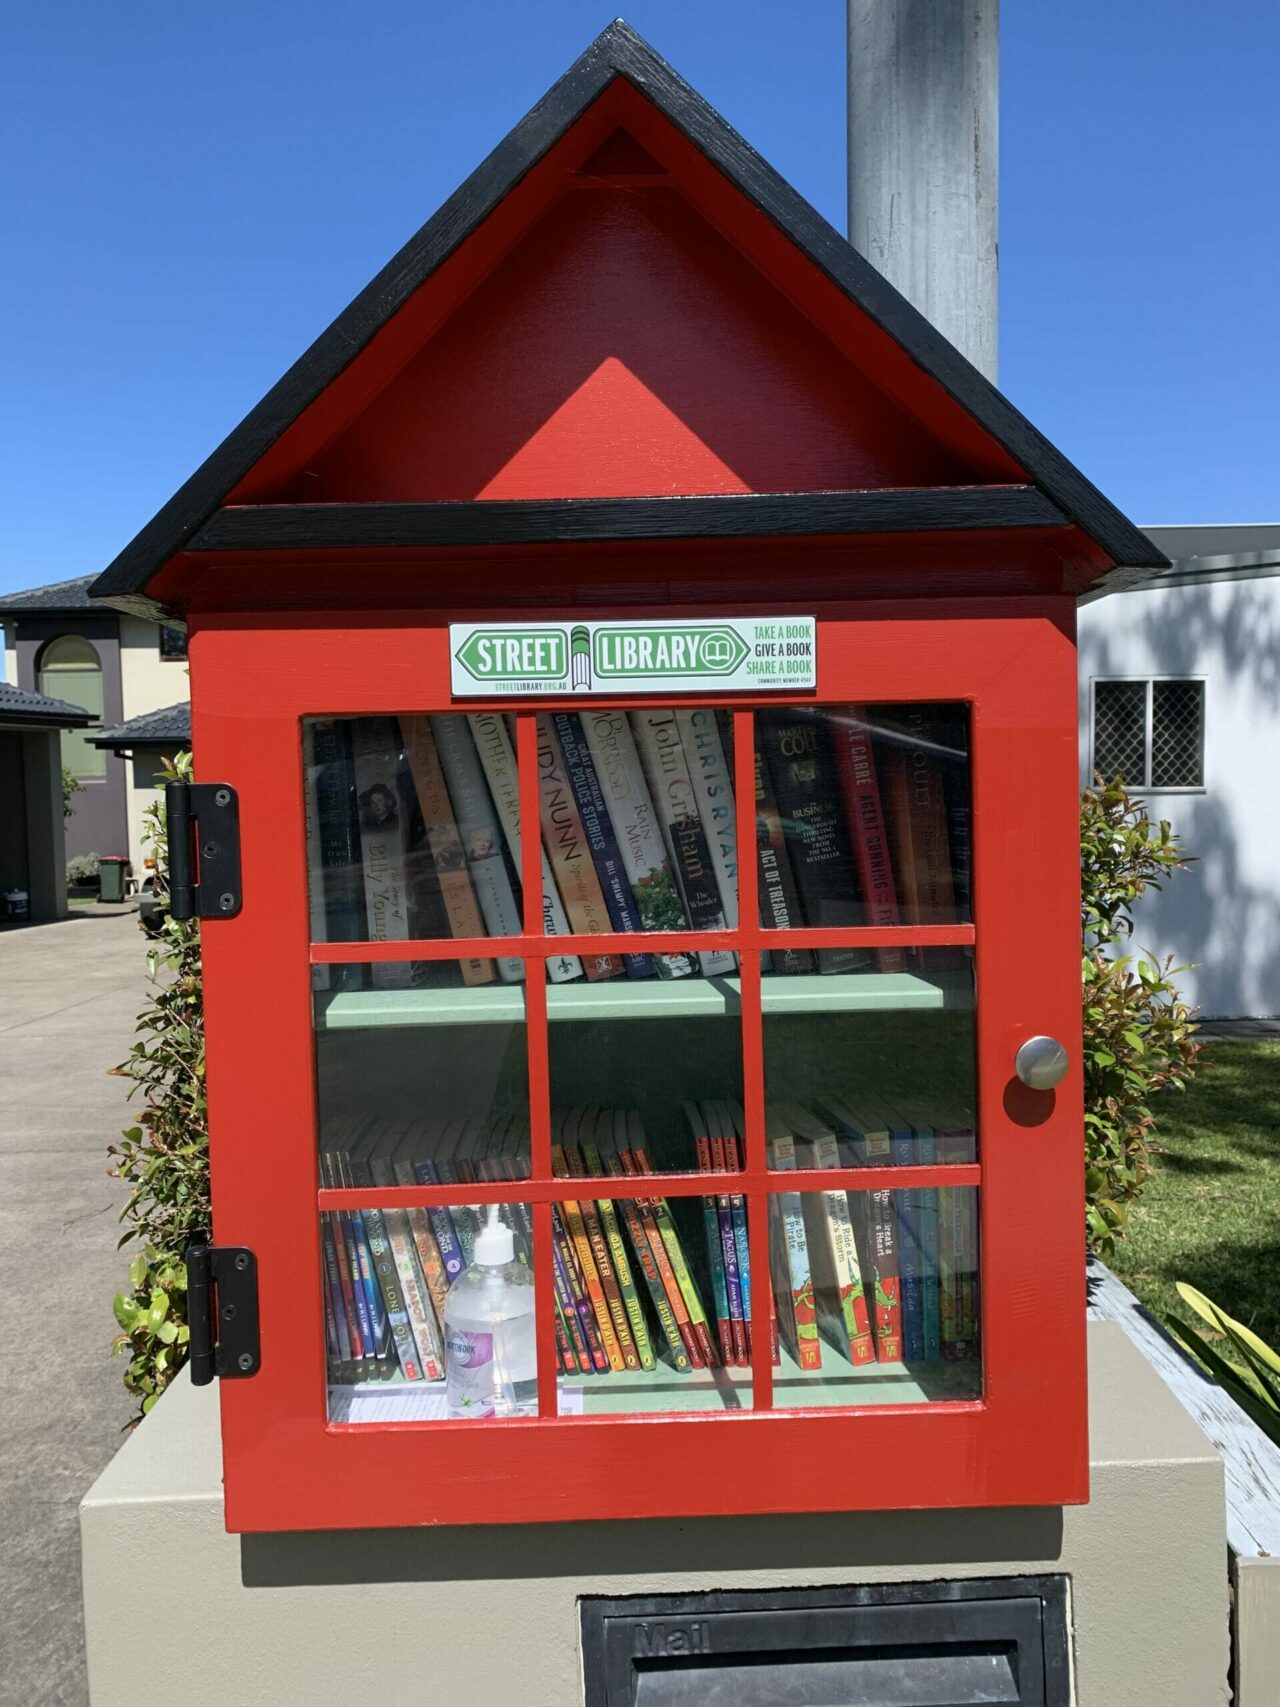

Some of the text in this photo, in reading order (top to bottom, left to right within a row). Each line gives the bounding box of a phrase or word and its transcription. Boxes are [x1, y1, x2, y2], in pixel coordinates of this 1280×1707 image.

[754, 624, 811, 640] TAKE A BOOK
[477, 635, 701, 672] STREET LIBRARY
[755, 642, 812, 657] GIVE A BOOK
[746, 660, 812, 675] SHARE A BOOK
[495, 682, 567, 692] STREETLIBRARY.ORG.AU
[849, 729, 865, 743] LE
[555, 714, 606, 851] OUTBACK POLICE STORIES
[577, 743, 606, 812] GREAT AUSTRALIAN
[647, 717, 704, 880] John Grisham
[690, 712, 738, 880] CHRIS RYAN
[859, 793, 880, 831] AGENT
[544, 786, 582, 862] NUNN
[634, 803, 653, 841] RAIN
[624, 824, 647, 868] MUSIC
[867, 837, 889, 889] RUNNING
[367, 843, 391, 942] Billy Young
[605, 860, 616, 876] BILL
[620, 910, 633, 934] MARS
[760, 849, 791, 931] ACT OF TREASON
[642, 1207, 648, 1217] 1
[656, 1206, 664, 1217] 2
[706, 1197, 713, 1207] 3
[720, 1197, 728, 1207] 4
[733, 1197, 741, 1207] 5
[836, 1195, 846, 1213] How
[881, 1189, 890, 1207] How
[883, 1210, 891, 1220] to
[370, 1210, 386, 1241] OLVES
[431, 1214, 449, 1254] BEYOND
[437, 1207, 451, 1238] OLVES
[786, 1221, 796, 1250] Pirate
[792, 1207, 806, 1253] How to Be
[828, 1194, 845, 1263] Dragon's Storm
[841, 1215, 848, 1225] to
[873, 1192, 885, 1257] Dragon's Heart
[884, 1222, 894, 1247] Break
[587, 1218, 611, 1277] MAN EATER
[601, 1202, 630, 1286] ANACONDA AMBUSH
[724, 1230, 737, 1264] TAGUS
[842, 1228, 852, 1248] Ride
[577, 1237, 596, 1282] TROUBLE
[640, 1251, 657, 1280] TRAP
[385, 1286, 400, 1314] LONE
[595, 1299, 609, 1328] JUSTIN
[729, 1283, 740, 1317] ADAM BLADE
[610, 1298, 632, 1346] JUSTIN D'ATH
[627, 1297, 647, 1345] JUSTIN D'ATH
[657, 1300, 672, 1330] JUSTIN
[668, 1328, 680, 1347] D'ATH
[634, 1621, 712, 1655] Mail
